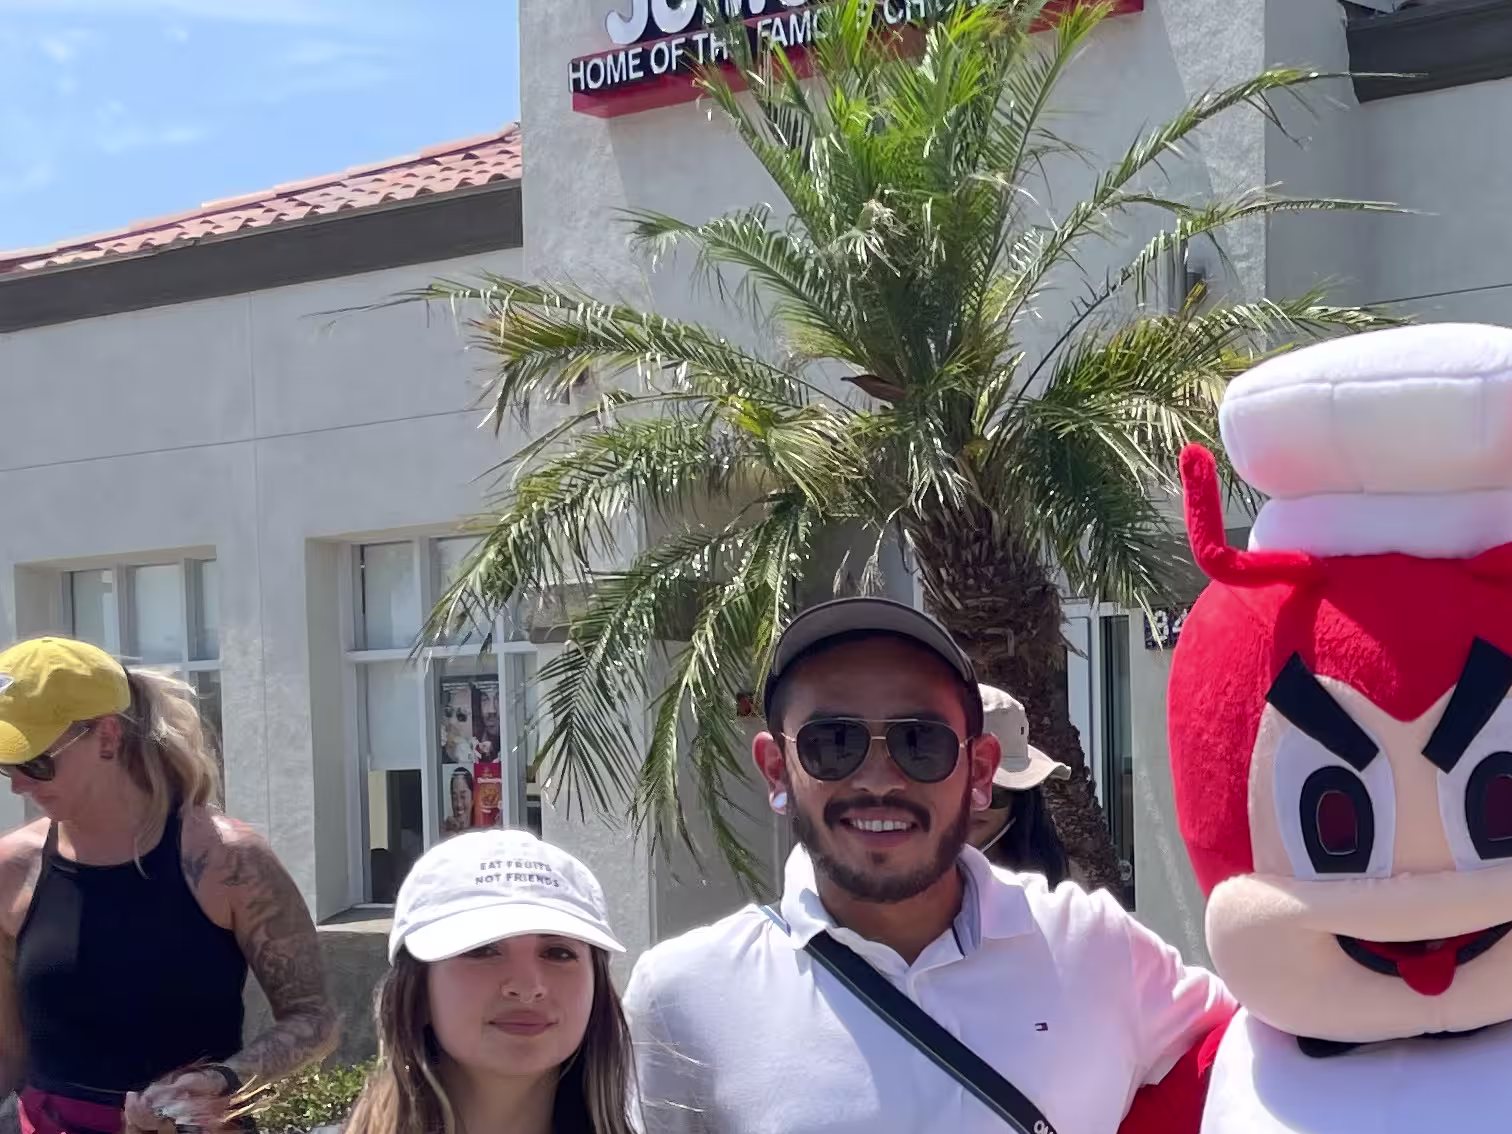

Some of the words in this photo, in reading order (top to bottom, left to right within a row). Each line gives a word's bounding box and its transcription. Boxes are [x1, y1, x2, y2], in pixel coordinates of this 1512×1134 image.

[568, 46, 644, 92] HOME
[650, 37, 684, 74] OF
[692, 31, 740, 64] TH
[480, 861, 502, 871] EAT
[506, 860, 552, 872] FRUITS
[475, 873, 502, 885] NOT
[506, 872, 559, 887] FRIENDS
